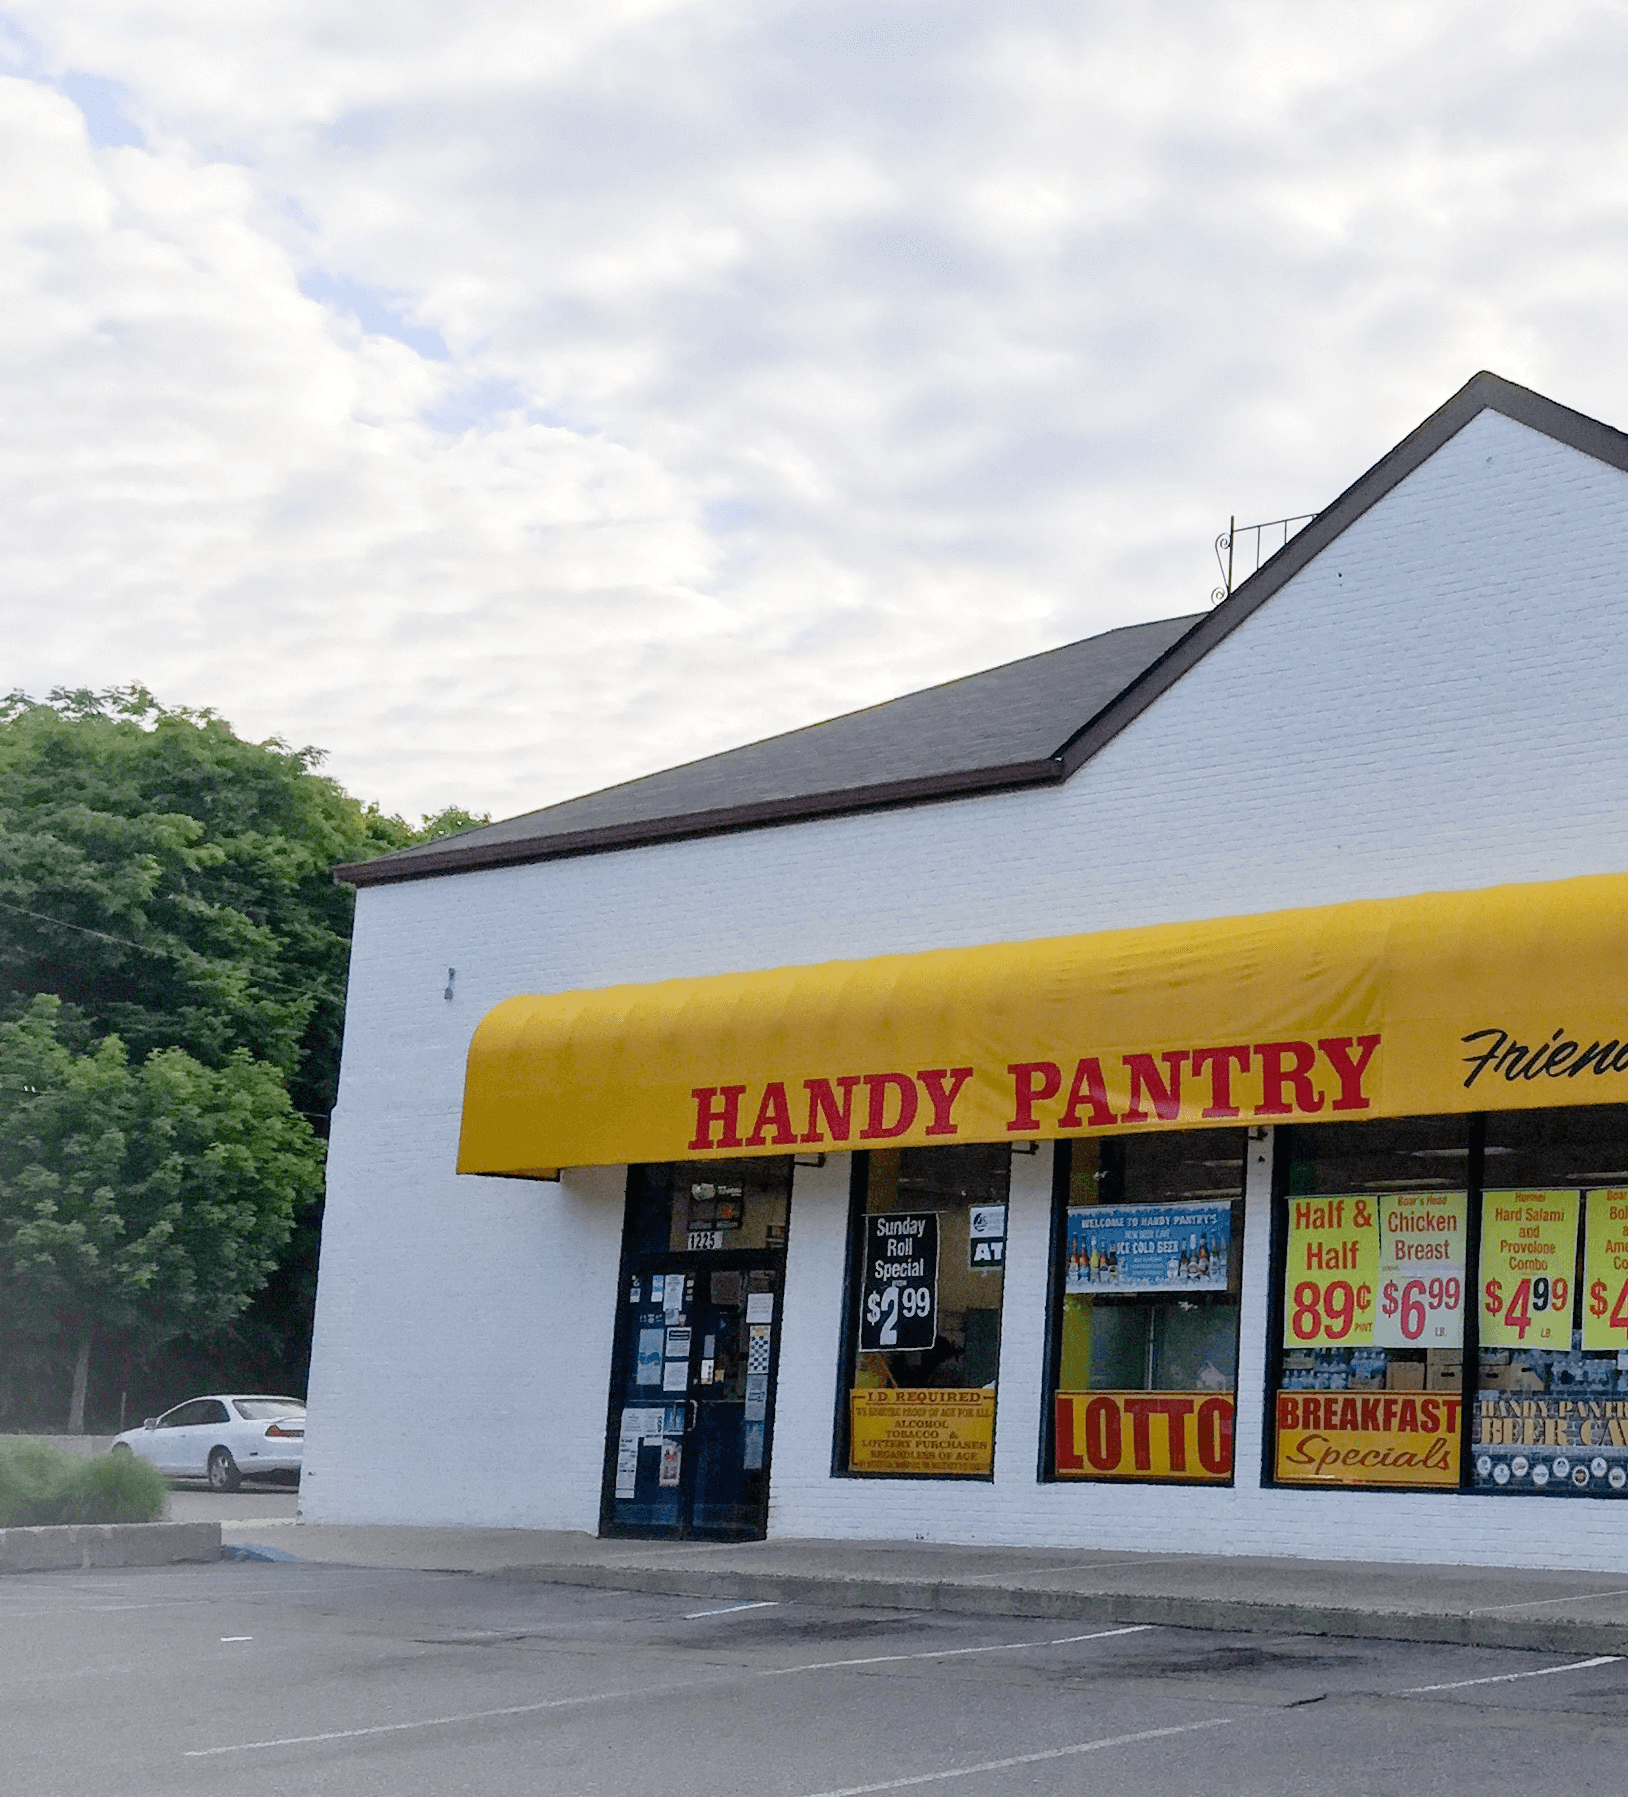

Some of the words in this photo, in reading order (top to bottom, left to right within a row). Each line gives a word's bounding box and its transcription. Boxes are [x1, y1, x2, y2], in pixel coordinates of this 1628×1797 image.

[688, 1067, 973, 1150] HANDY
[1005, 1034, 1382, 1132] PANTRY
[1081, 1217, 1124, 1229] WELCOME
[1127, 1216, 1138, 1227] TO
[1141, 1216, 1170, 1226] HANDY
[1173, 1214, 1218, 1225] PANTRY'S
[1294, 1200, 1345, 1230] Half
[1353, 1199, 1373, 1229] &
[1387, 1211, 1458, 1233] Chicken
[1495, 1208, 1522, 1222] Hard
[1525, 1208, 1565, 1222] Salami
[877, 1217, 926, 1237] Sunday
[1518, 1226, 1540, 1239] and
[690, 1232, 715, 1249] 1225
[887, 1238, 913, 1257] Roll
[1116, 1242, 1131, 1255] ICE
[1132, 1241, 1155, 1254] COLD
[1157, 1240, 1180, 1253] BEER
[1500, 1241, 1556, 1255] Provolone
[1306, 1240, 1360, 1271] Half
[1394, 1239, 1451, 1261] Breast
[874, 1258, 924, 1281] Special
[1509, 1256, 1548, 1271] Combo
[895, 1391, 981, 1403] REQUIRED
[1279, 1397, 1462, 1434] BREAKFAST
[1480, 1400, 1549, 1417] HANDY
[894, 1420, 949, 1429] ALCOHOL
[1480, 1418, 1568, 1445] BEER
[885, 1430, 939, 1439] TOBACCO
[1055, 1396, 1234, 1475] LOTTO
[861, 1440, 911, 1449] LOTTERY
[915, 1440, 988, 1449] PURCHASES
[1286, 1434, 1451, 1475] Specials
